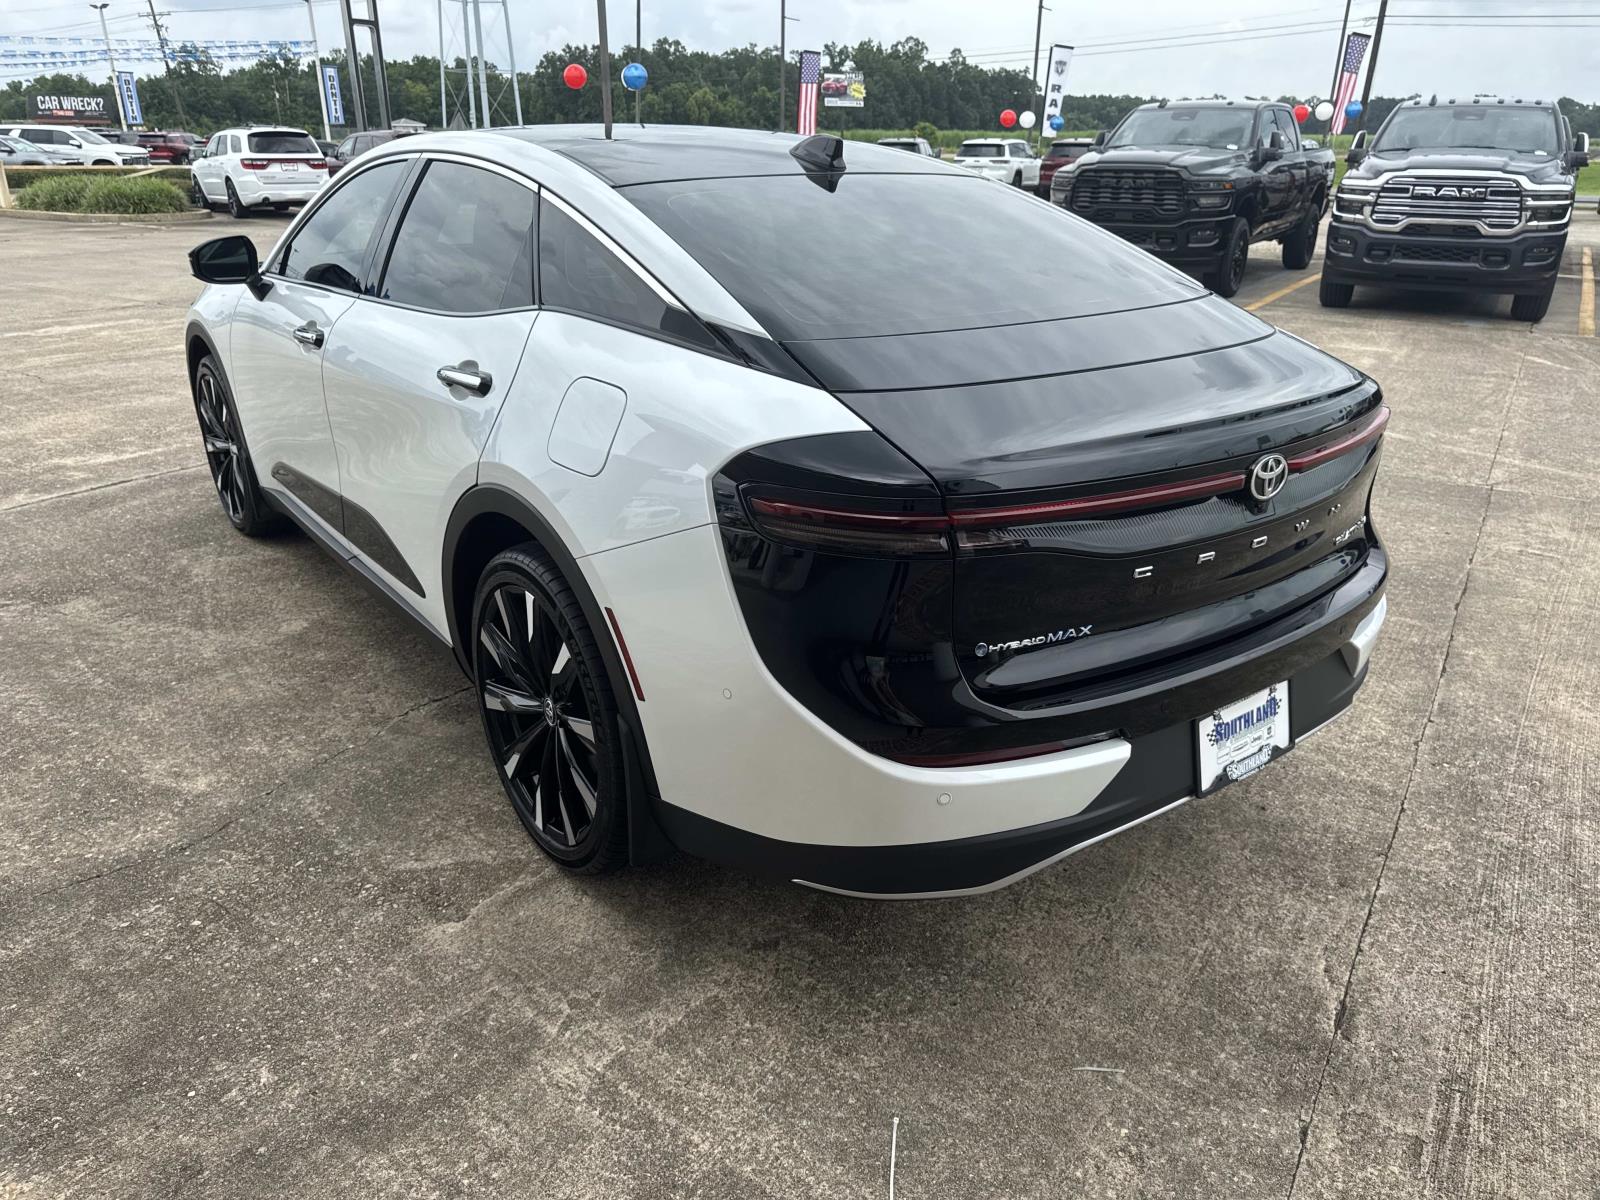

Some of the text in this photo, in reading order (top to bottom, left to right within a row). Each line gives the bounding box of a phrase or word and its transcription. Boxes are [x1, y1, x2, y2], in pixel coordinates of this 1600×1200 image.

[37, 95, 104, 111] CAR WRECK?
[1100, 178, 1154, 188] RAM
[1413, 186, 1486, 198] RAM
[1133, 503, 1341, 578] CROWN
[1215, 696, 1277, 742] SOUTHLAND
